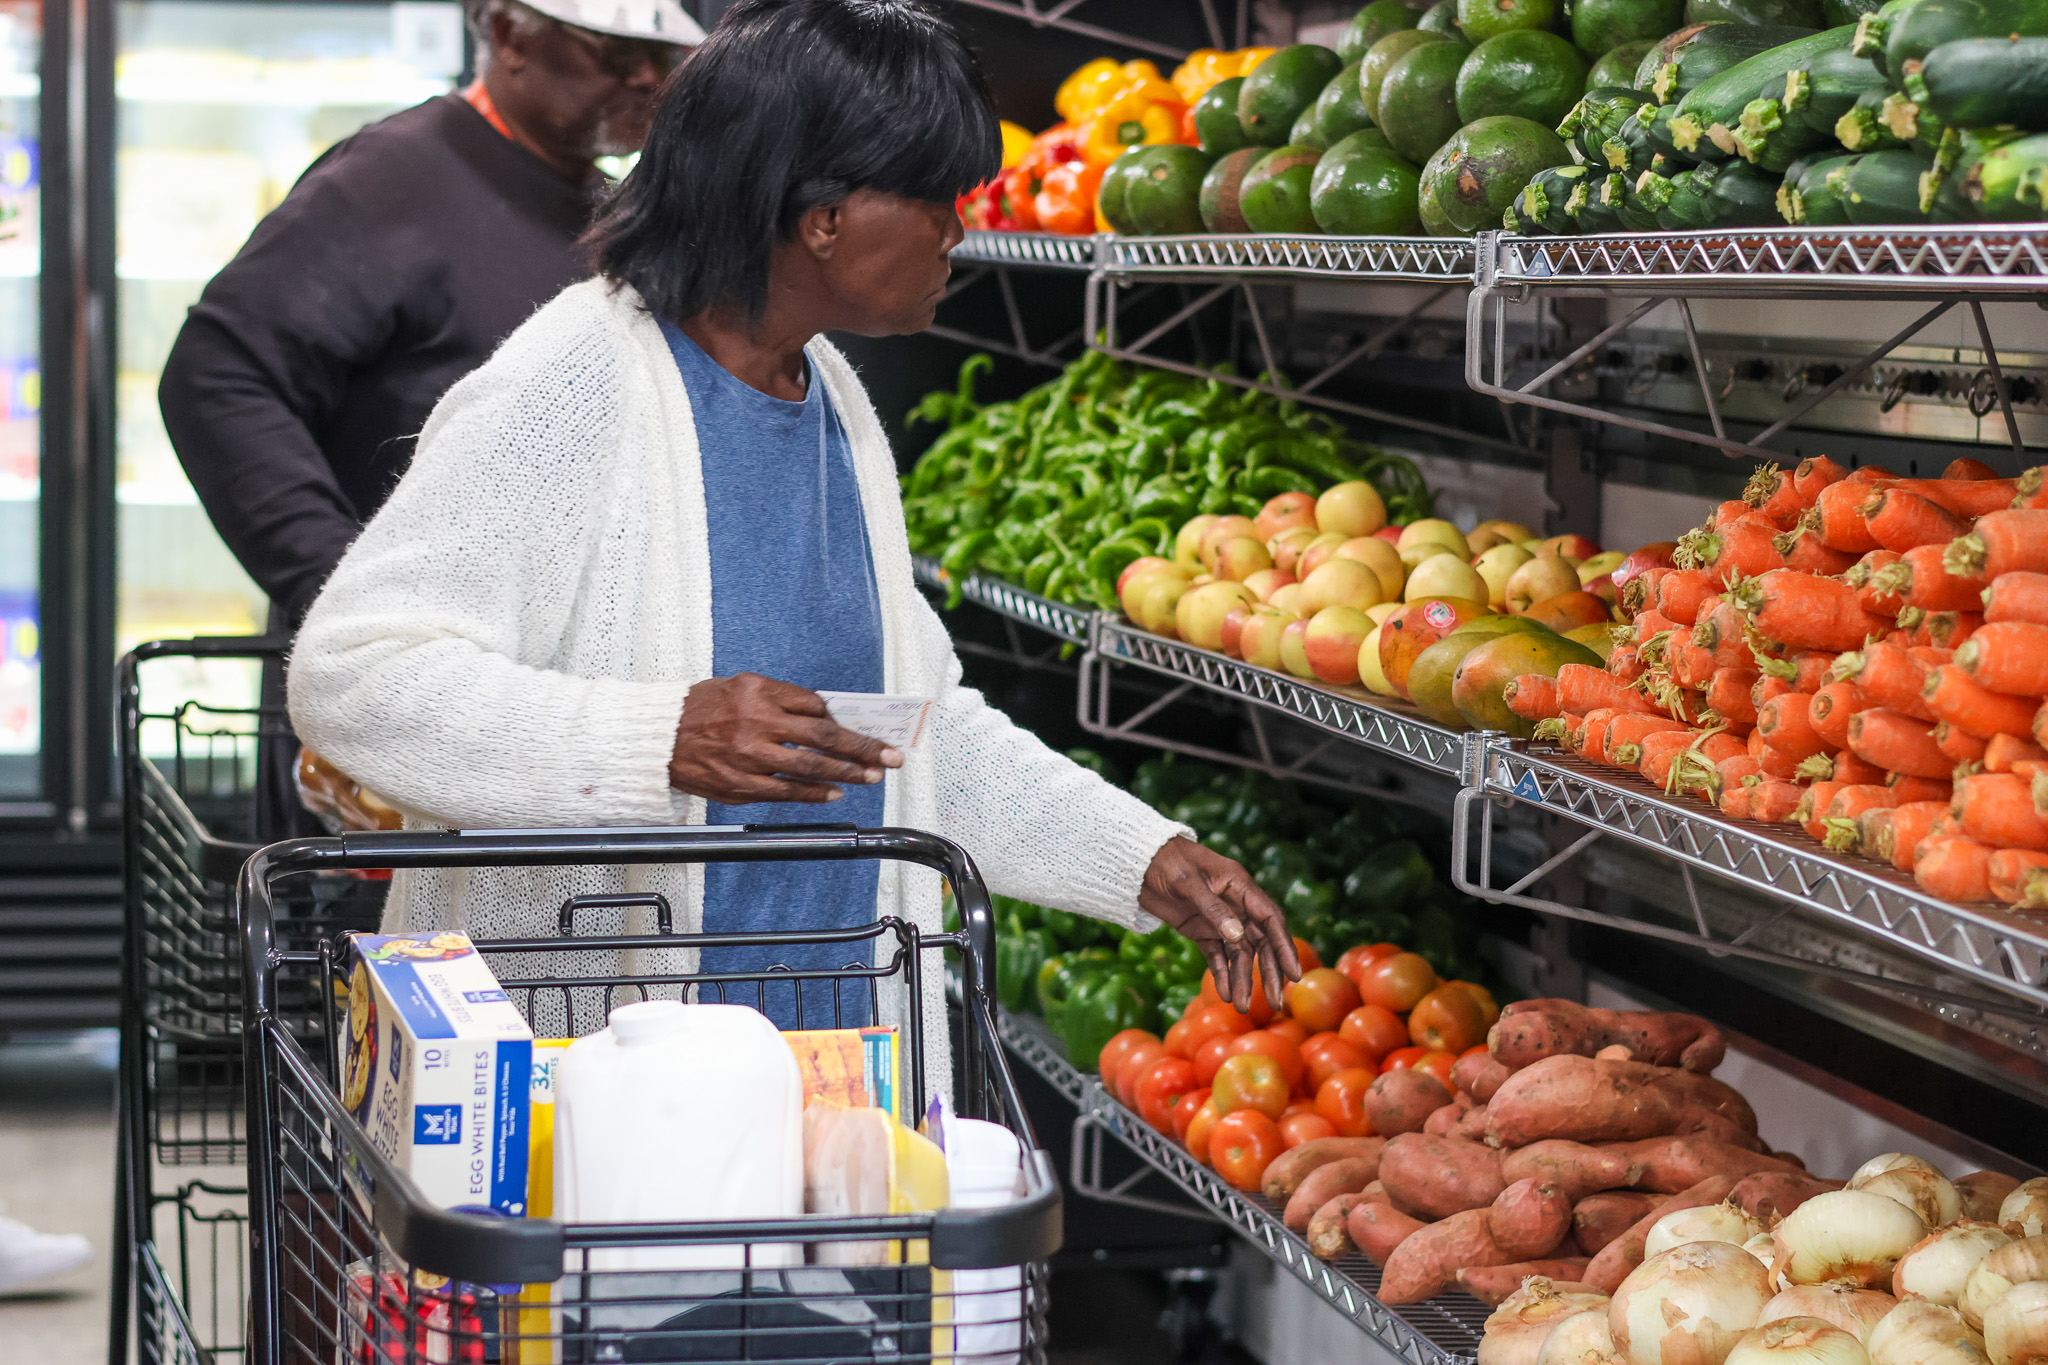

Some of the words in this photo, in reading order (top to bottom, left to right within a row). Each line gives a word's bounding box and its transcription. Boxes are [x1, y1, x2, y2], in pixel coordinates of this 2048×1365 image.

[424, 1049, 442, 1071] 10
[474, 1050, 489, 1096] BITES
[530, 1061, 549, 1090] 32
[383, 1081, 398, 1120] EGG
[376, 1101, 400, 1154] WHITE
[443, 1108, 452, 1141] Member's
[471, 1101, 487, 1156] WHITE
[470, 1159, 485, 1195] EGG
